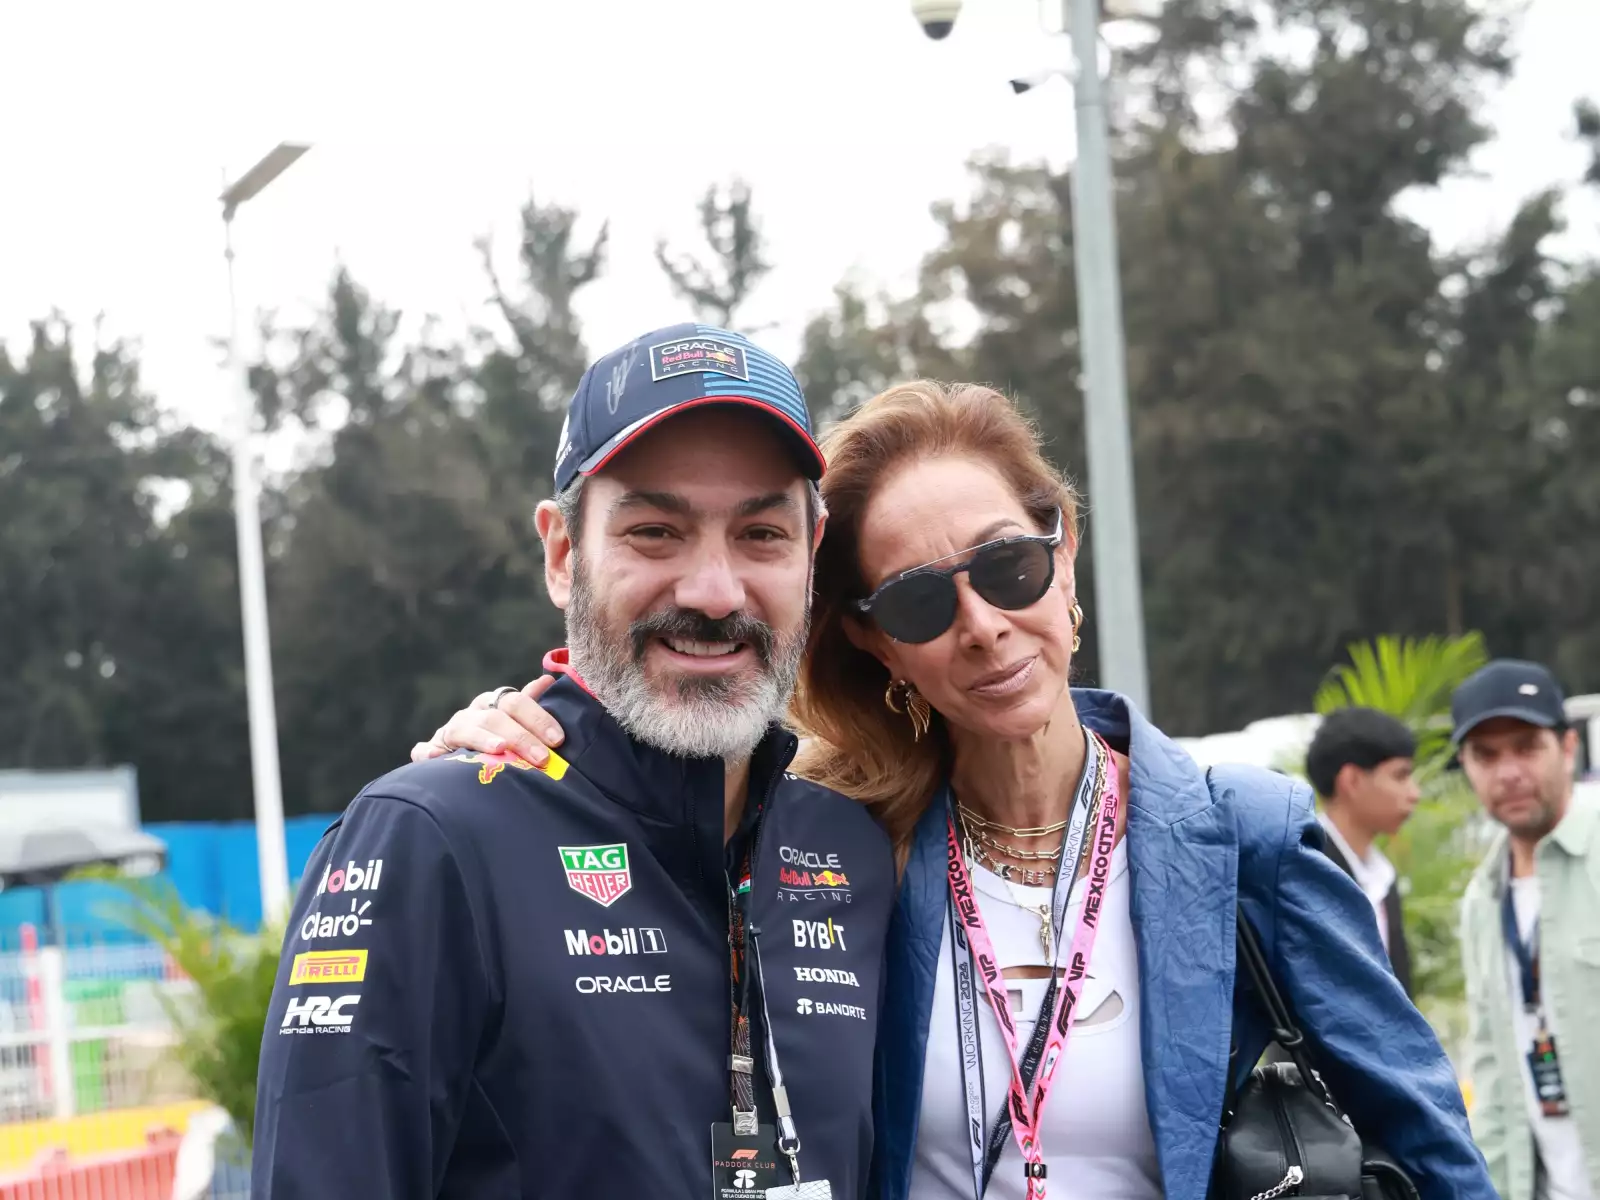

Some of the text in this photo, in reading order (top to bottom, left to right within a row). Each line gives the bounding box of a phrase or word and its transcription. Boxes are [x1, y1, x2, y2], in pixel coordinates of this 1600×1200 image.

[661, 342, 736, 357] ORACLE
[663, 361, 739, 373] RACING
[564, 849, 622, 869] TAG
[779, 846, 841, 868] ORACLE
[1060, 820, 1083, 881] WORKING
[570, 873, 627, 902] HEUER
[777, 891, 852, 904] RACING
[301, 911, 359, 940] Claro
[792, 917, 847, 952] BYBIT
[564, 928, 638, 956] Mobil
[296, 956, 360, 979] PIRELLI
[793, 967, 860, 988] HONDA
[979, 954, 998, 984] VIP
[1068, 952, 1086, 981] VIP
[575, 975, 672, 994] ORACLE
[281, 994, 361, 1027] HRC
[815, 1002, 867, 1020] BANORTE
[959, 962, 977, 1070] WORKING 2024
[279, 1025, 351, 1035] Honda RACING
[715, 1161, 752, 1169] PADDOCK
